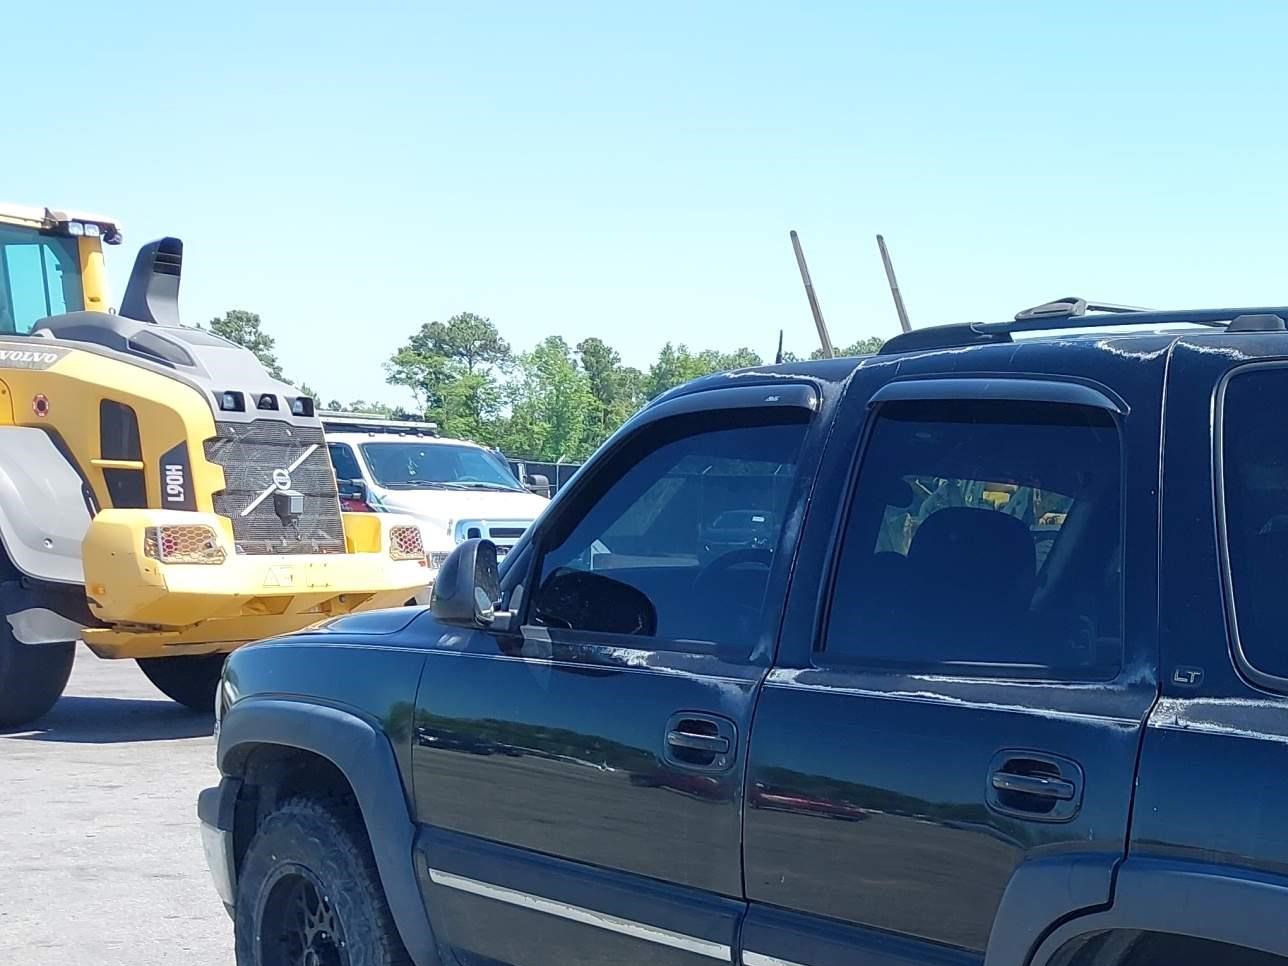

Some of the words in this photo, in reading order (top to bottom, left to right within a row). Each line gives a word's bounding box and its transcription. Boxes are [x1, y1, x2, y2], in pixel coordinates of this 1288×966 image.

[0, 350, 58, 363] VOLVO
[165, 464, 185, 502] L90H
[1174, 669, 1201, 683] LT
